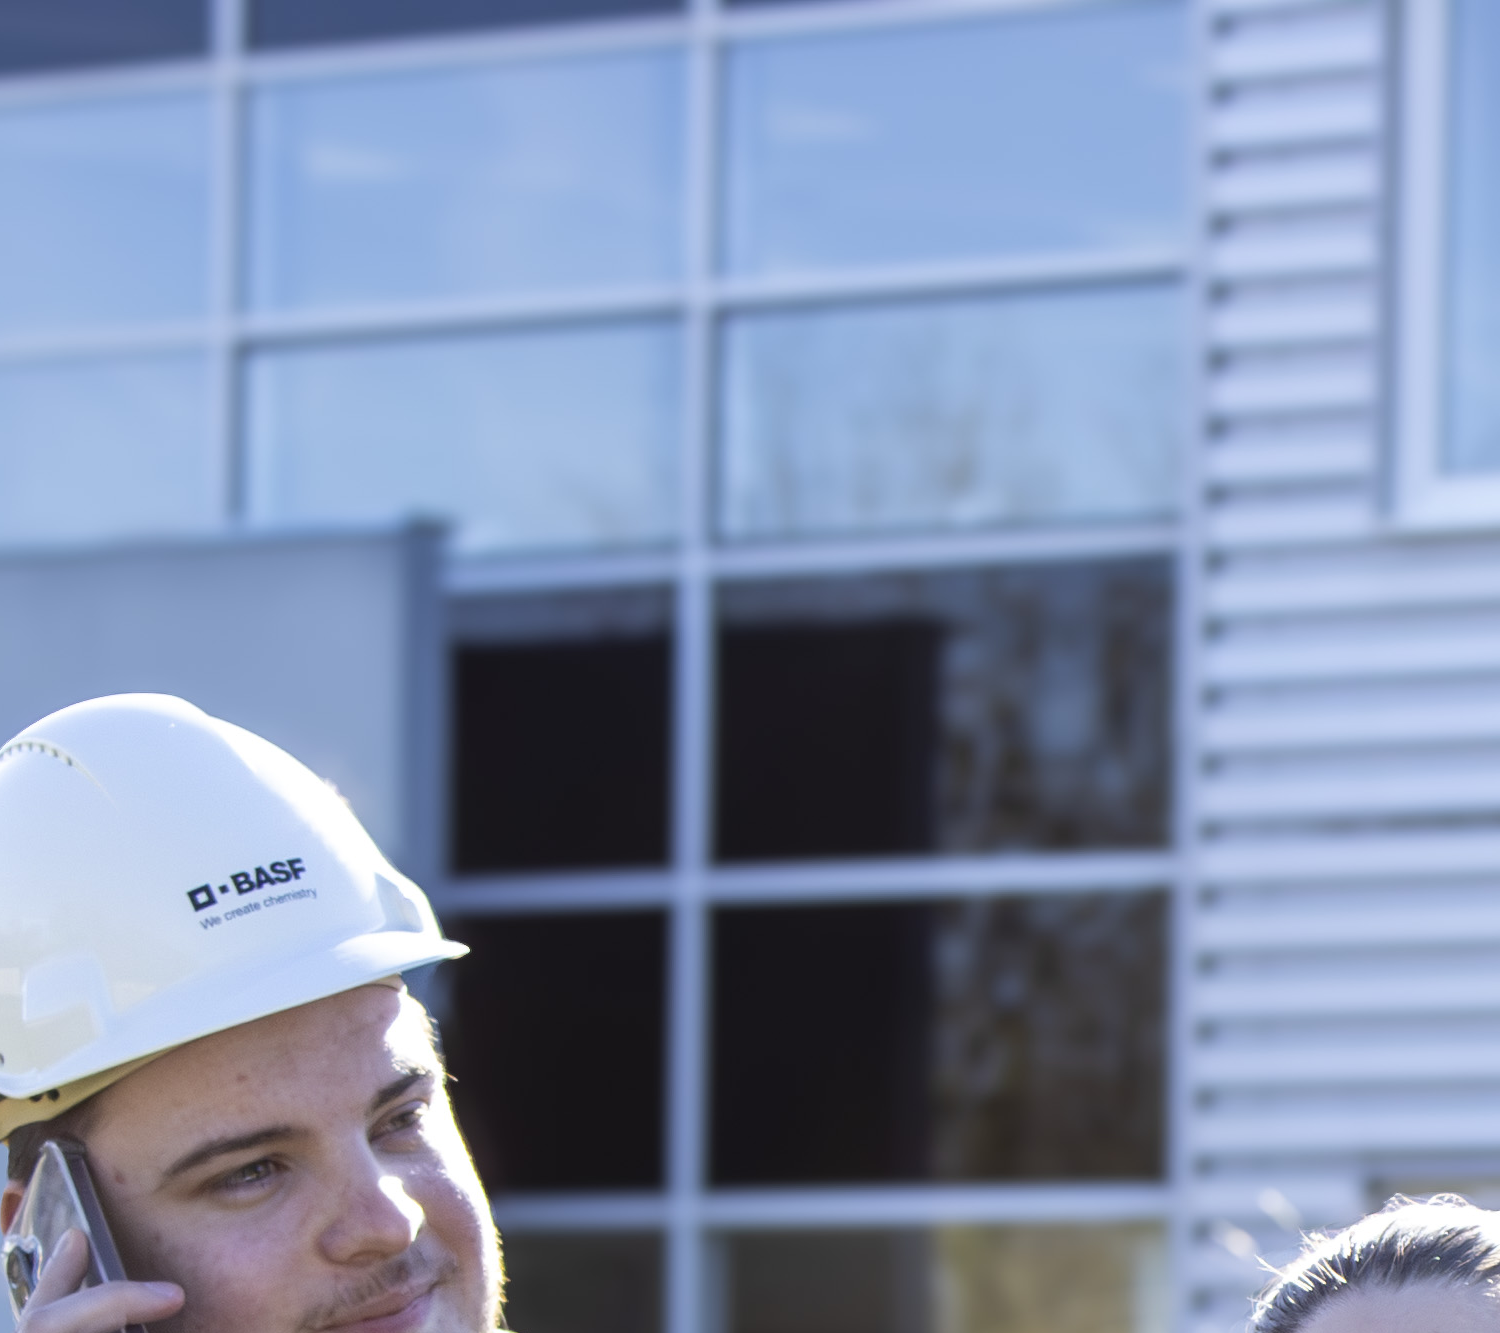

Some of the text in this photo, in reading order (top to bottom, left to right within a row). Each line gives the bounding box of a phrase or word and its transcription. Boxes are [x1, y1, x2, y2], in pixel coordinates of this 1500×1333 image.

[230, 858, 306, 896] BASF
[199, 887, 318, 931] We create chemistry
